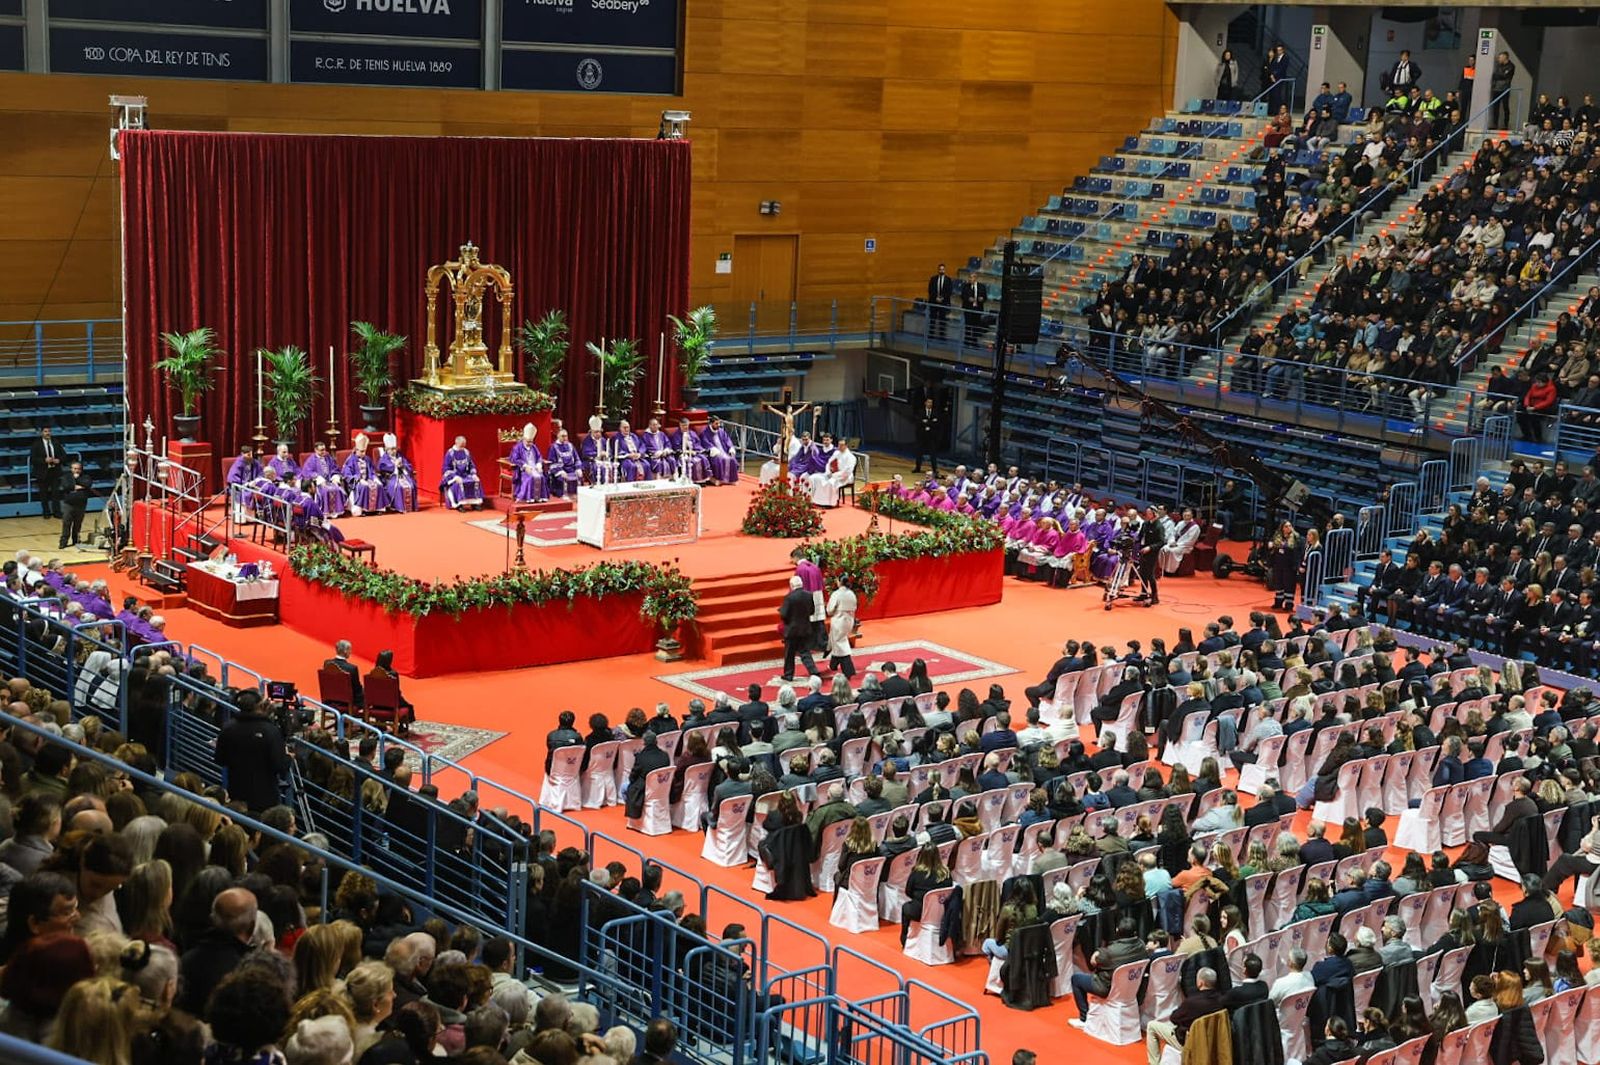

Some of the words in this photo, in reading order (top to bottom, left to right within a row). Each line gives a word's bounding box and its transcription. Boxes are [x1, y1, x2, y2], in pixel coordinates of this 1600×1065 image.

[357, 0, 451, 14] HUELVA
[591, 0, 639, 13] Seabery
[109, 47, 144, 62] COPA
[146, 50, 163, 63] DEL
[166, 51, 184, 64] REY
[187, 52, 199, 65] DE
[202, 52, 230, 67] TENIS
[315, 57, 347, 70] R.C.R.
[349, 58, 362, 71] DE
[364, 59, 390, 71] TENIS
[392, 60, 427, 72] HUELVA
[429, 61, 453, 73] 1889
